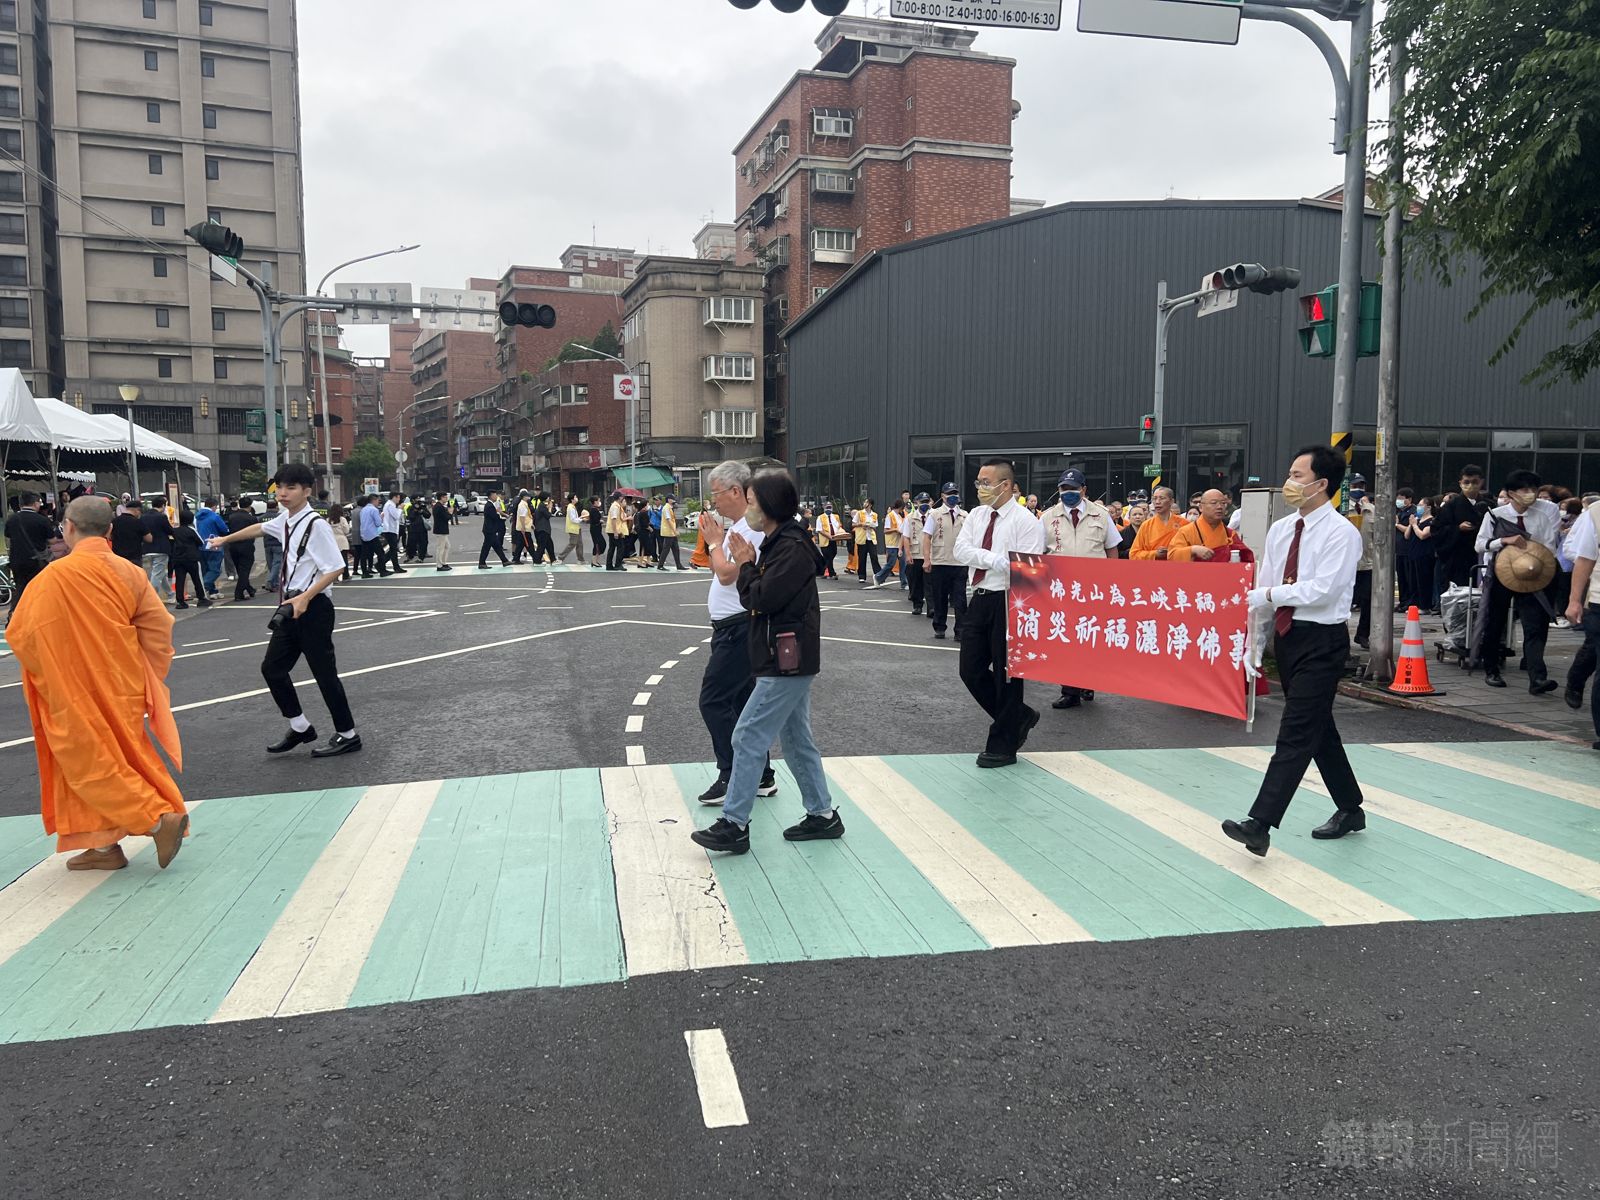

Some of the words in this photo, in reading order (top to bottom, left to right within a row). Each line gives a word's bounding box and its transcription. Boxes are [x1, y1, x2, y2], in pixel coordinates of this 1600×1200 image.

[1050, 578, 1216, 614] 佛光山為三峽車禍
[1016, 607, 1246, 671] 消災祈福灑淨佛事
